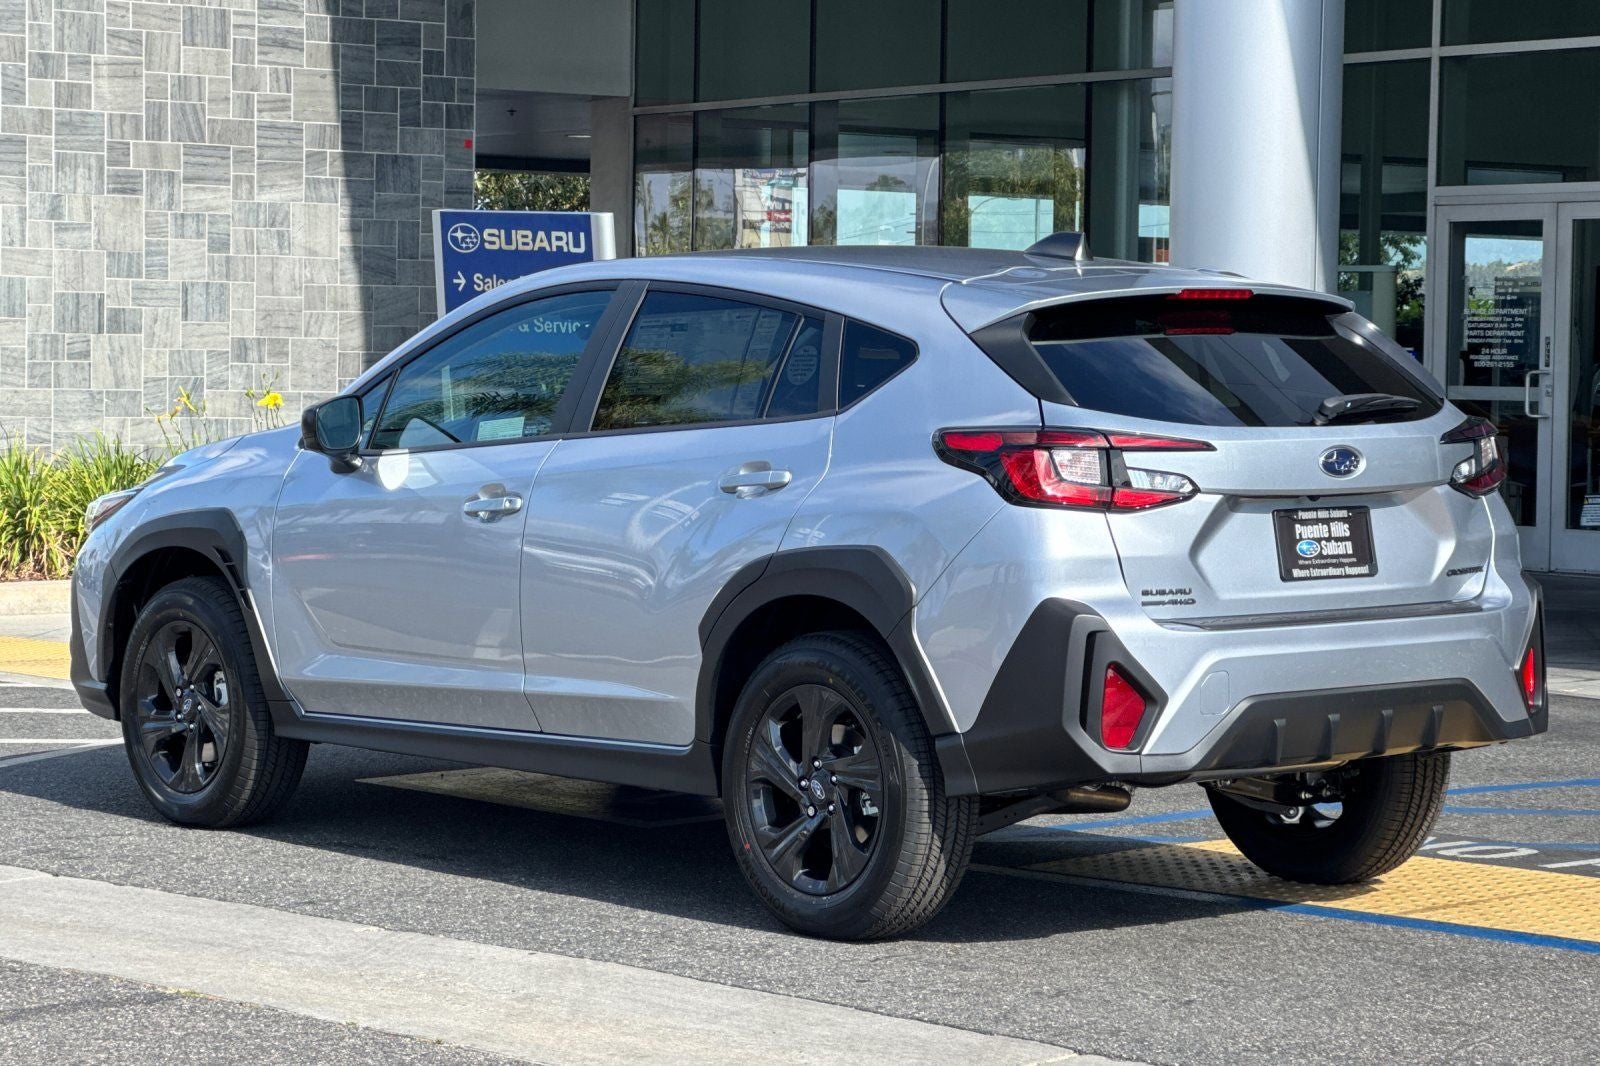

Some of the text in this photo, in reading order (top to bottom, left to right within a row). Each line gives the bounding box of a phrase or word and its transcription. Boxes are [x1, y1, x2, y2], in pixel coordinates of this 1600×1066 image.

[484, 228, 586, 254] SUBARU
[1294, 521, 1350, 539] Puente Hills
[1321, 540, 1353, 555] Subaru
[1292, 565, 1369, 578] Where Extraordinary Happens!
[1141, 587, 1193, 597] SUBARU
[1159, 598, 1197, 607] AWD
